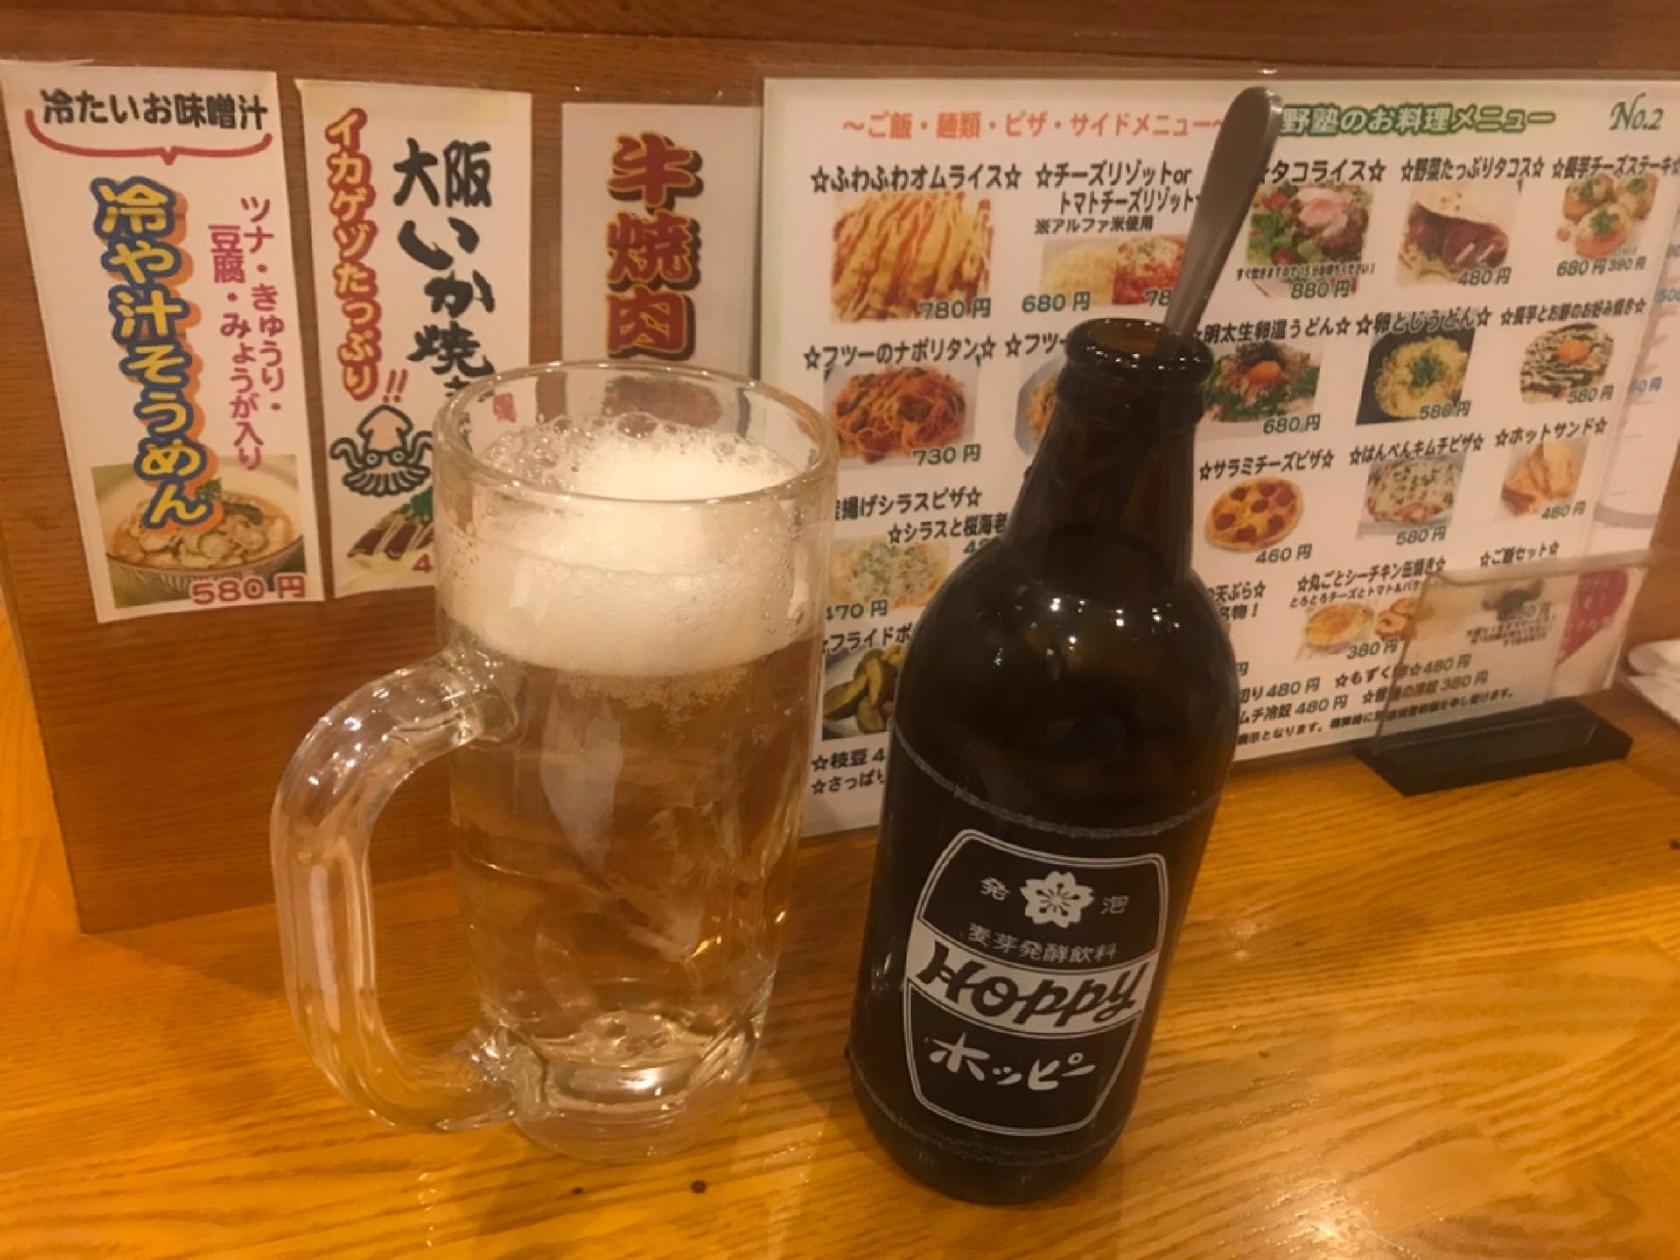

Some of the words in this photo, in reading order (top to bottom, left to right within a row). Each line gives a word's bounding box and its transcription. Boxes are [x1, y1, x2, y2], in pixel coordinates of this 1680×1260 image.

[40, 88, 269, 130] 冷たいお味噌汁
[1610, 92, 1664, 131] No.2
[605, 131, 704, 361] 牛焼肉
[91, 176, 222, 532] 冷や汁そうめん
[968, 922, 1118, 964] 麦芽発酵飲料
[916, 941, 1148, 1027] Hoppy
[929, 1031, 1097, 1091] ホッピー
